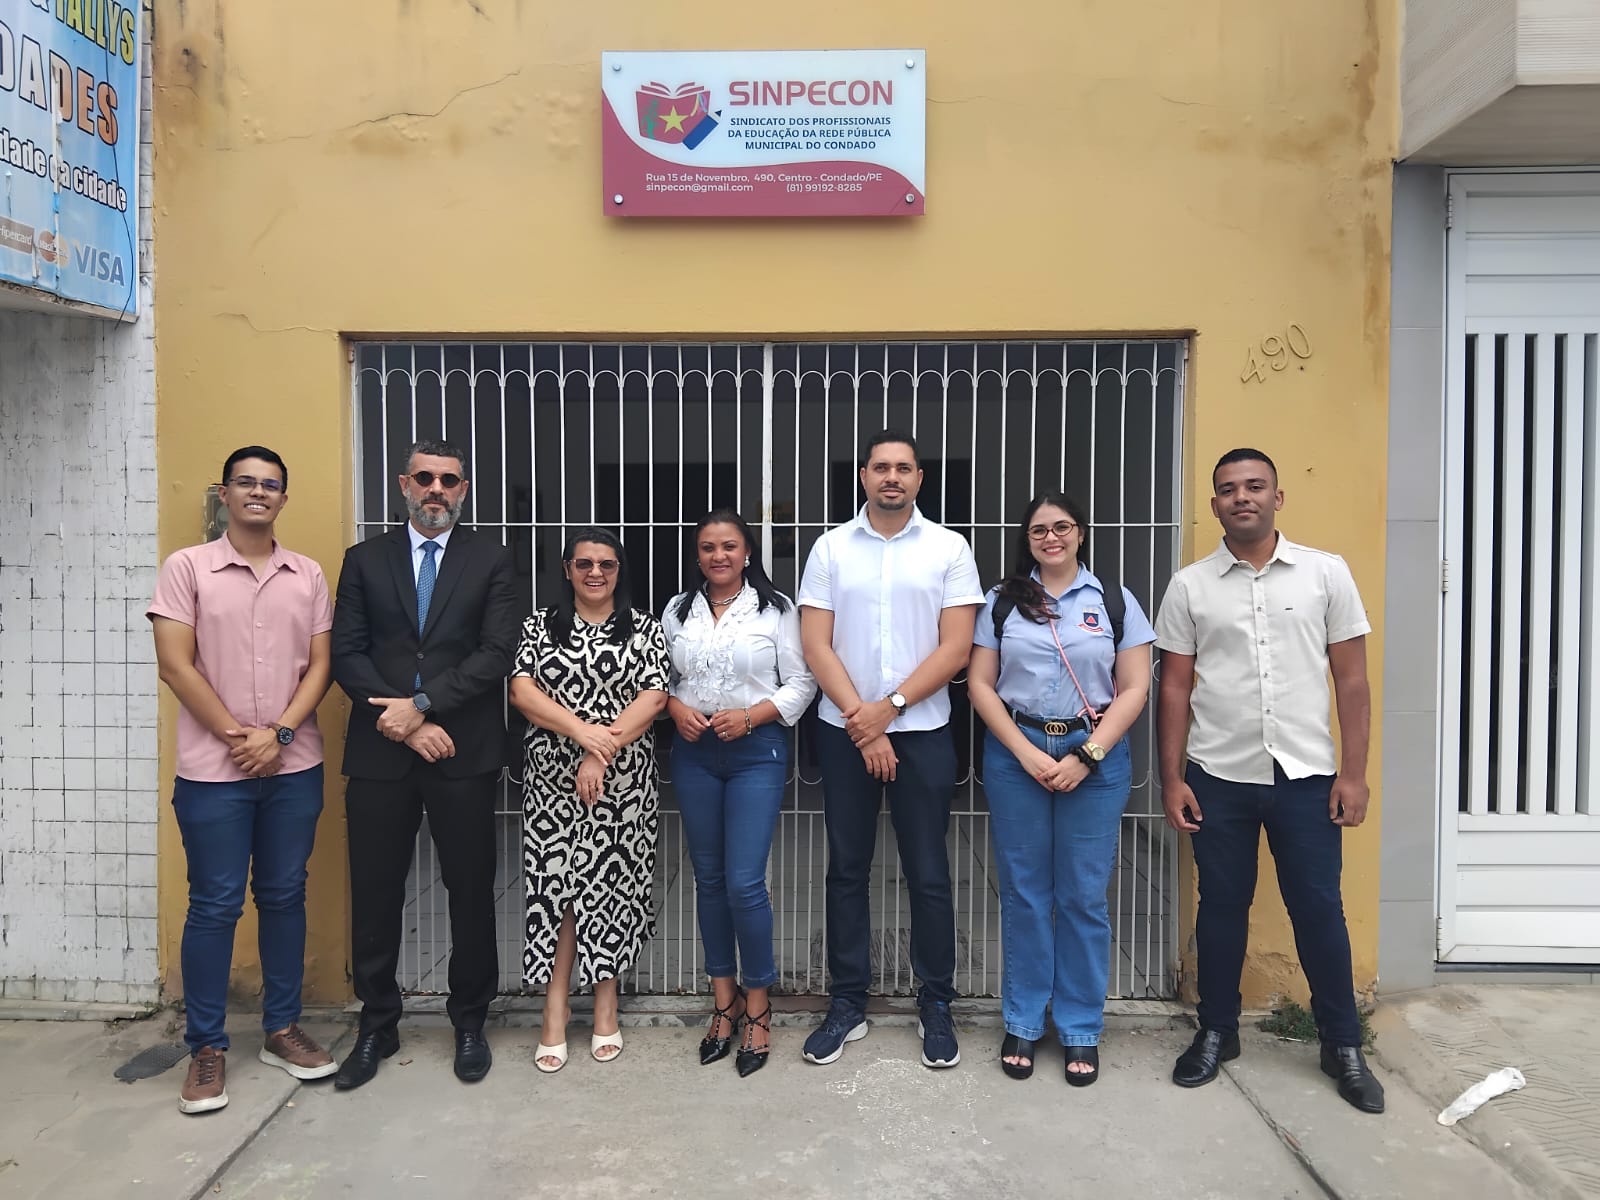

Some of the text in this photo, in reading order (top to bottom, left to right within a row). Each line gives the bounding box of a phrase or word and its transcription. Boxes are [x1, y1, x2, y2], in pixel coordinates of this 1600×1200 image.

[728, 80, 893, 106] SINPECON
[730, 116, 891, 126] SINDICATO DOS PROFISSIONAIS
[727, 127, 891, 140] DA EDUCAÇÃO DA REDE PÚBLICA
[745, 140, 876, 150] MUNICIPAL DO CONDADO
[646, 173, 666, 182] Rua
[667, 173, 678, 182] 15
[680, 173, 693, 182] de
[695, 173, 750, 183] Novembro,
[754, 173, 776, 183] 490,
[777, 173, 812, 182] Centro
[820, 172, 883, 183] Condado/PE
[73, 164, 128, 213] cidade
[646, 183, 863, 193] sinpecon@gmail.com (81) 99192-8285
[73, 241, 125, 287] VISA
[1240, 321, 1312, 384] 490
